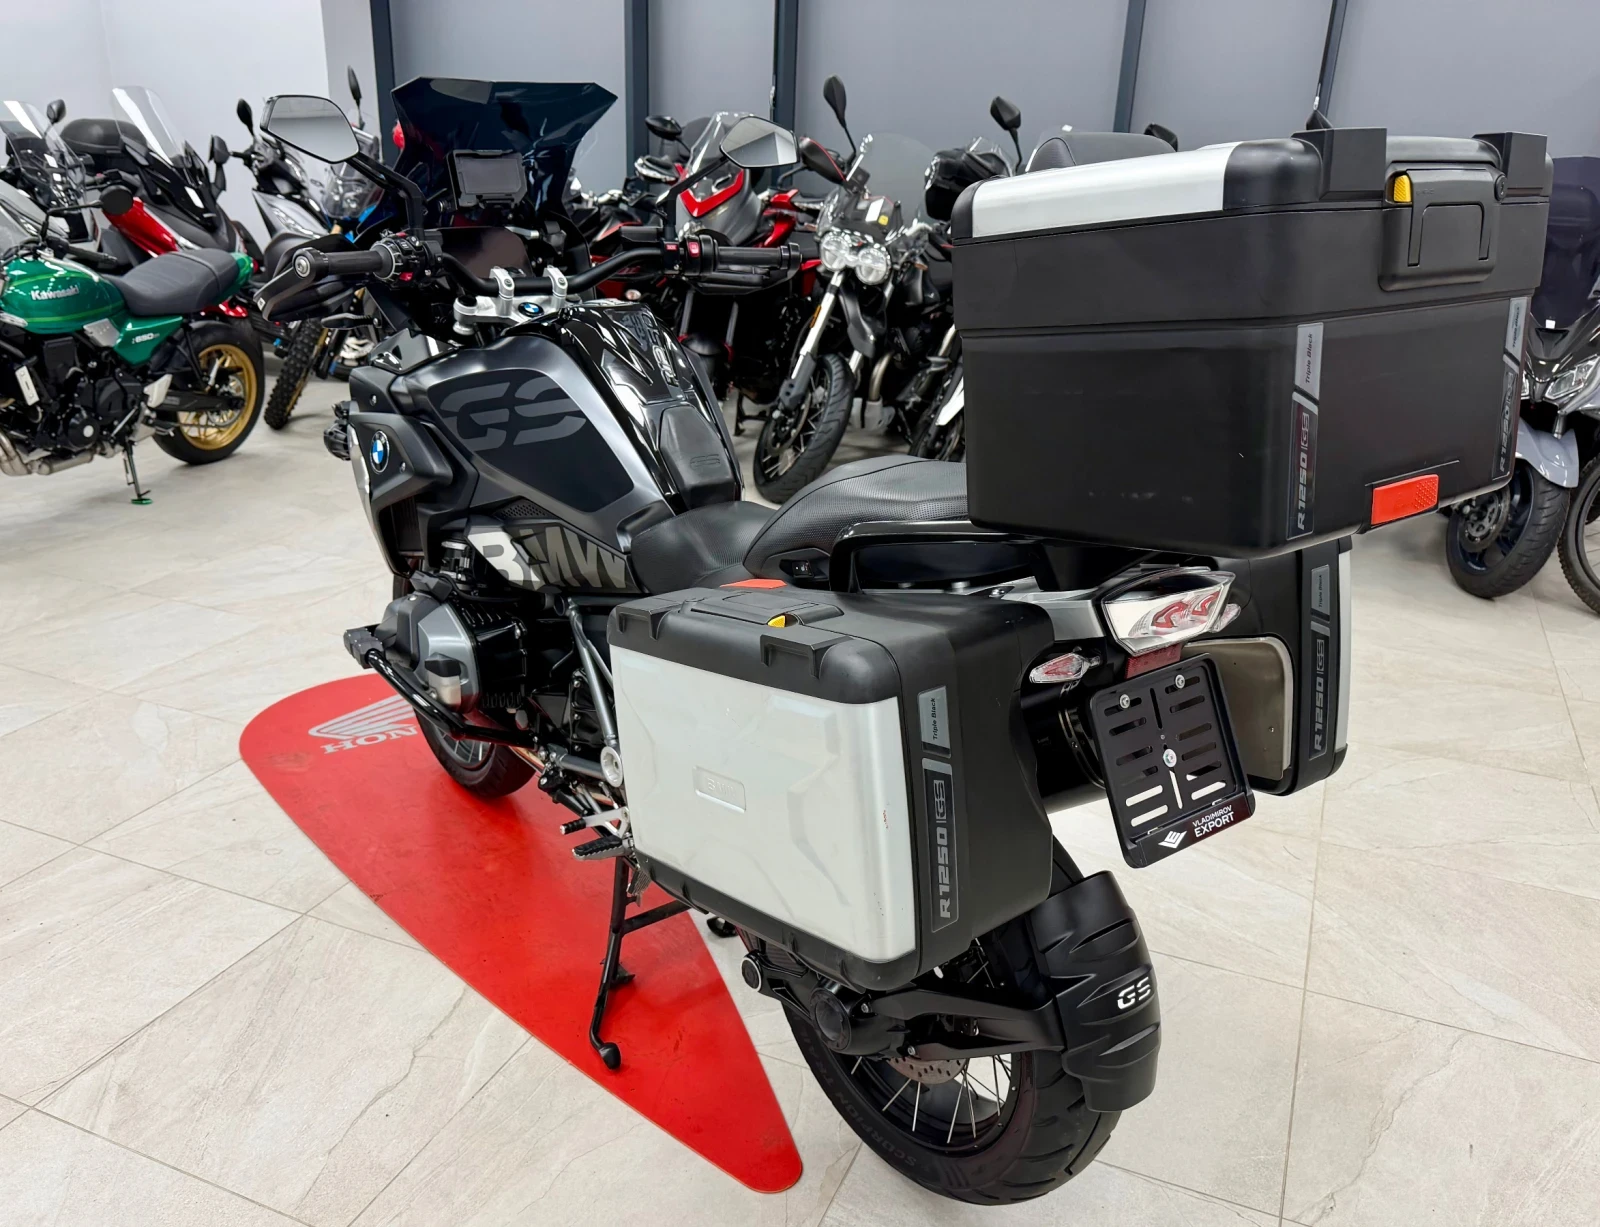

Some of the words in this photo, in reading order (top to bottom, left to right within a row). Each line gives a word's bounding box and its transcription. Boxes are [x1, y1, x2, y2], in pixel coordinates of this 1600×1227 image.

[31, 284, 80, 300] Kawasaki
[1305, 360, 1313, 384] Triple
[440, 376, 587, 451] GS
[1301, 412, 1310, 447] GS
[467, 526, 627, 590] BMW
[1316, 638, 1325, 672] GS
[931, 719, 939, 741] Triple
[934, 779, 947, 820] GS
[1192, 804, 1232, 827] VLADIMIROV
[1194, 811, 1235, 838] EXPORT
[1117, 976, 1151, 1010] GS
